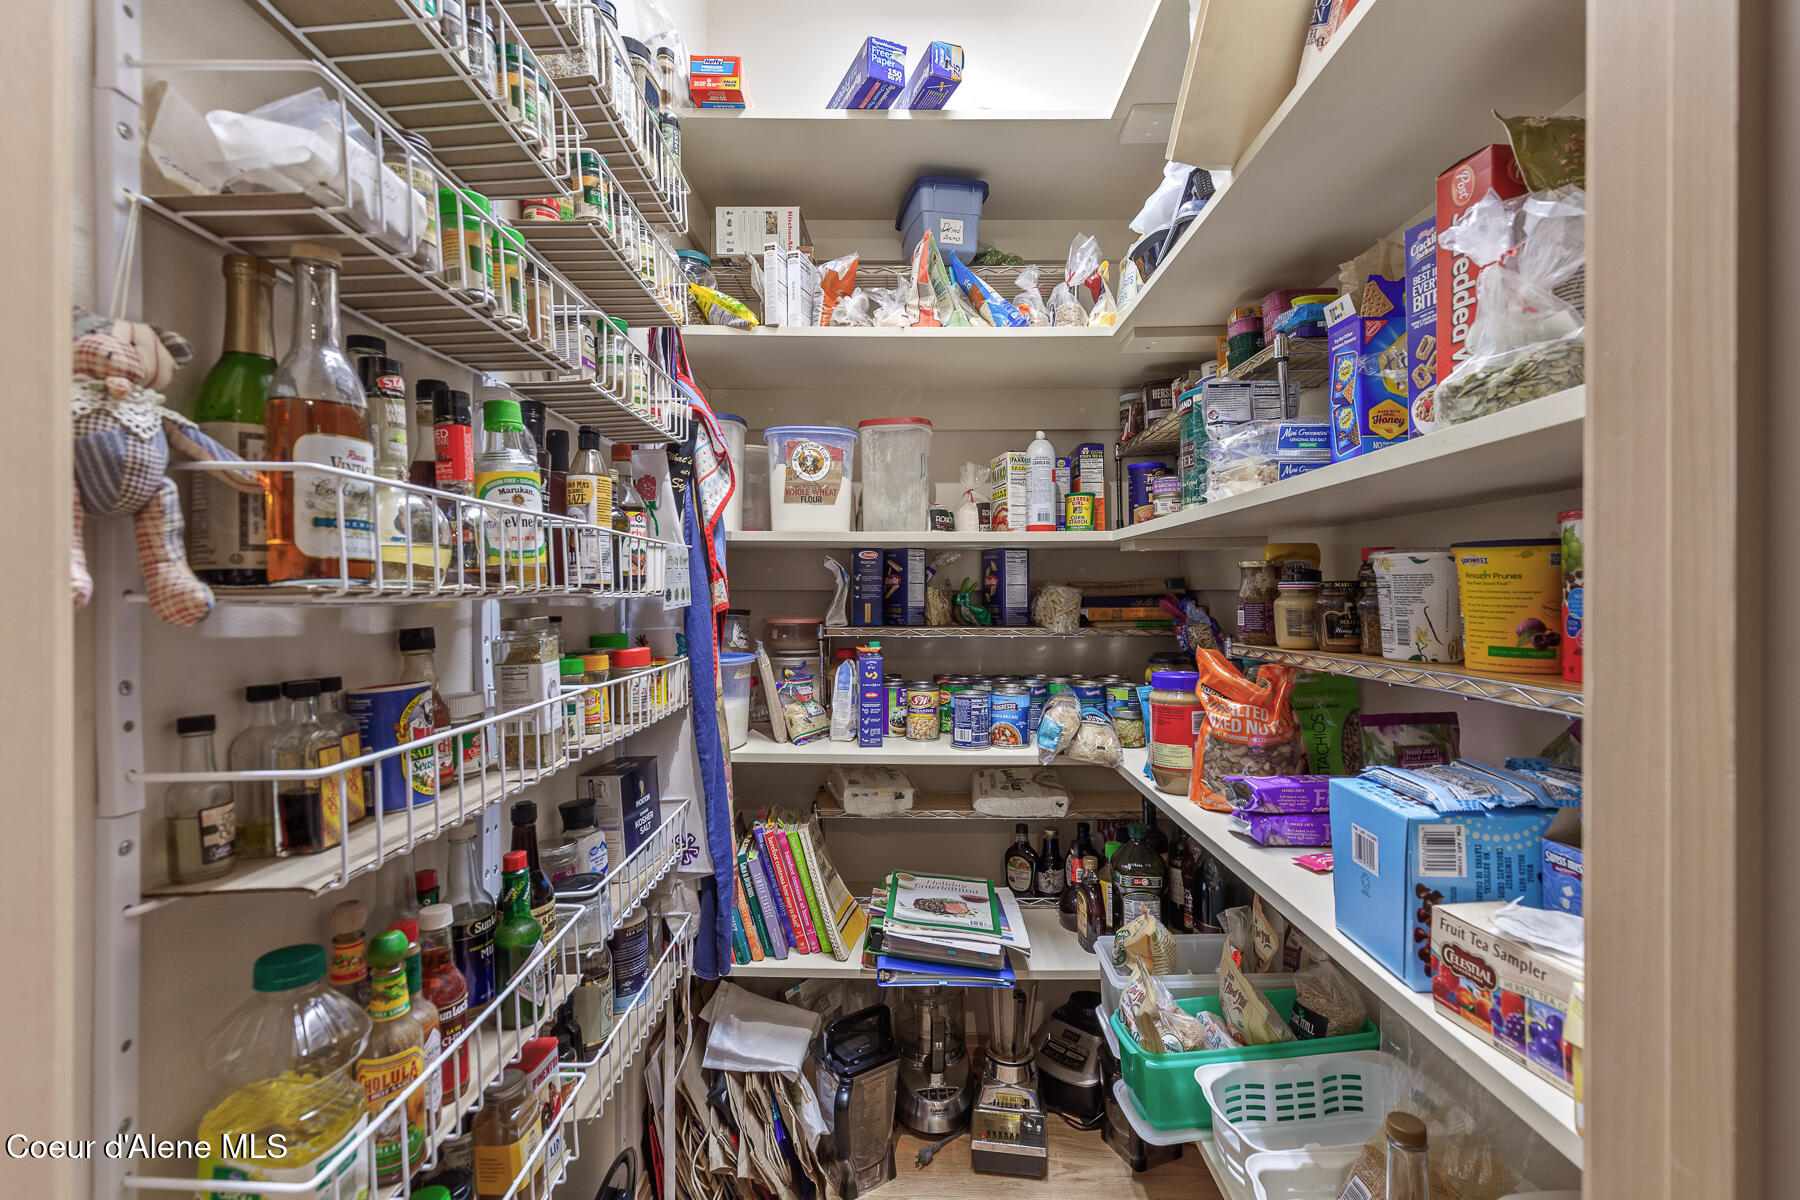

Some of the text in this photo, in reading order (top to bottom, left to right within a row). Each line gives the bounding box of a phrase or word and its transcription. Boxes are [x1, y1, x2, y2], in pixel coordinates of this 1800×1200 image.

[871, 54, 895, 67] Paper
[888, 68, 902, 79] 150
[1455, 169, 1471, 200] Post
[1413, 273, 1431, 286] BEST
[1372, 414, 1406, 428] Honey
[1281, 427, 1297, 440] Mini
[498, 486, 535, 496] Marukan
[785, 488, 838, 496] WHOLE WHEAT
[800, 496, 823, 504] FLOUR
[1461, 557, 1489, 565] SUNSWEET
[1246, 720, 1284, 736] NUTS
[411, 746, 433, 760] SALT
[635, 812, 654, 829] KOSHER
[639, 823, 651, 835] SALT
[1440, 917, 1548, 982] Fruit Tea Sampler
[1443, 947, 1493, 985] CELESTIAL
[1224, 982, 1249, 1008] Red Mill
[1504, 981, 1536, 997] HERBAL
[1300, 1018, 1315, 1036] MILL
[358, 1060, 420, 1096] CHOLULA
